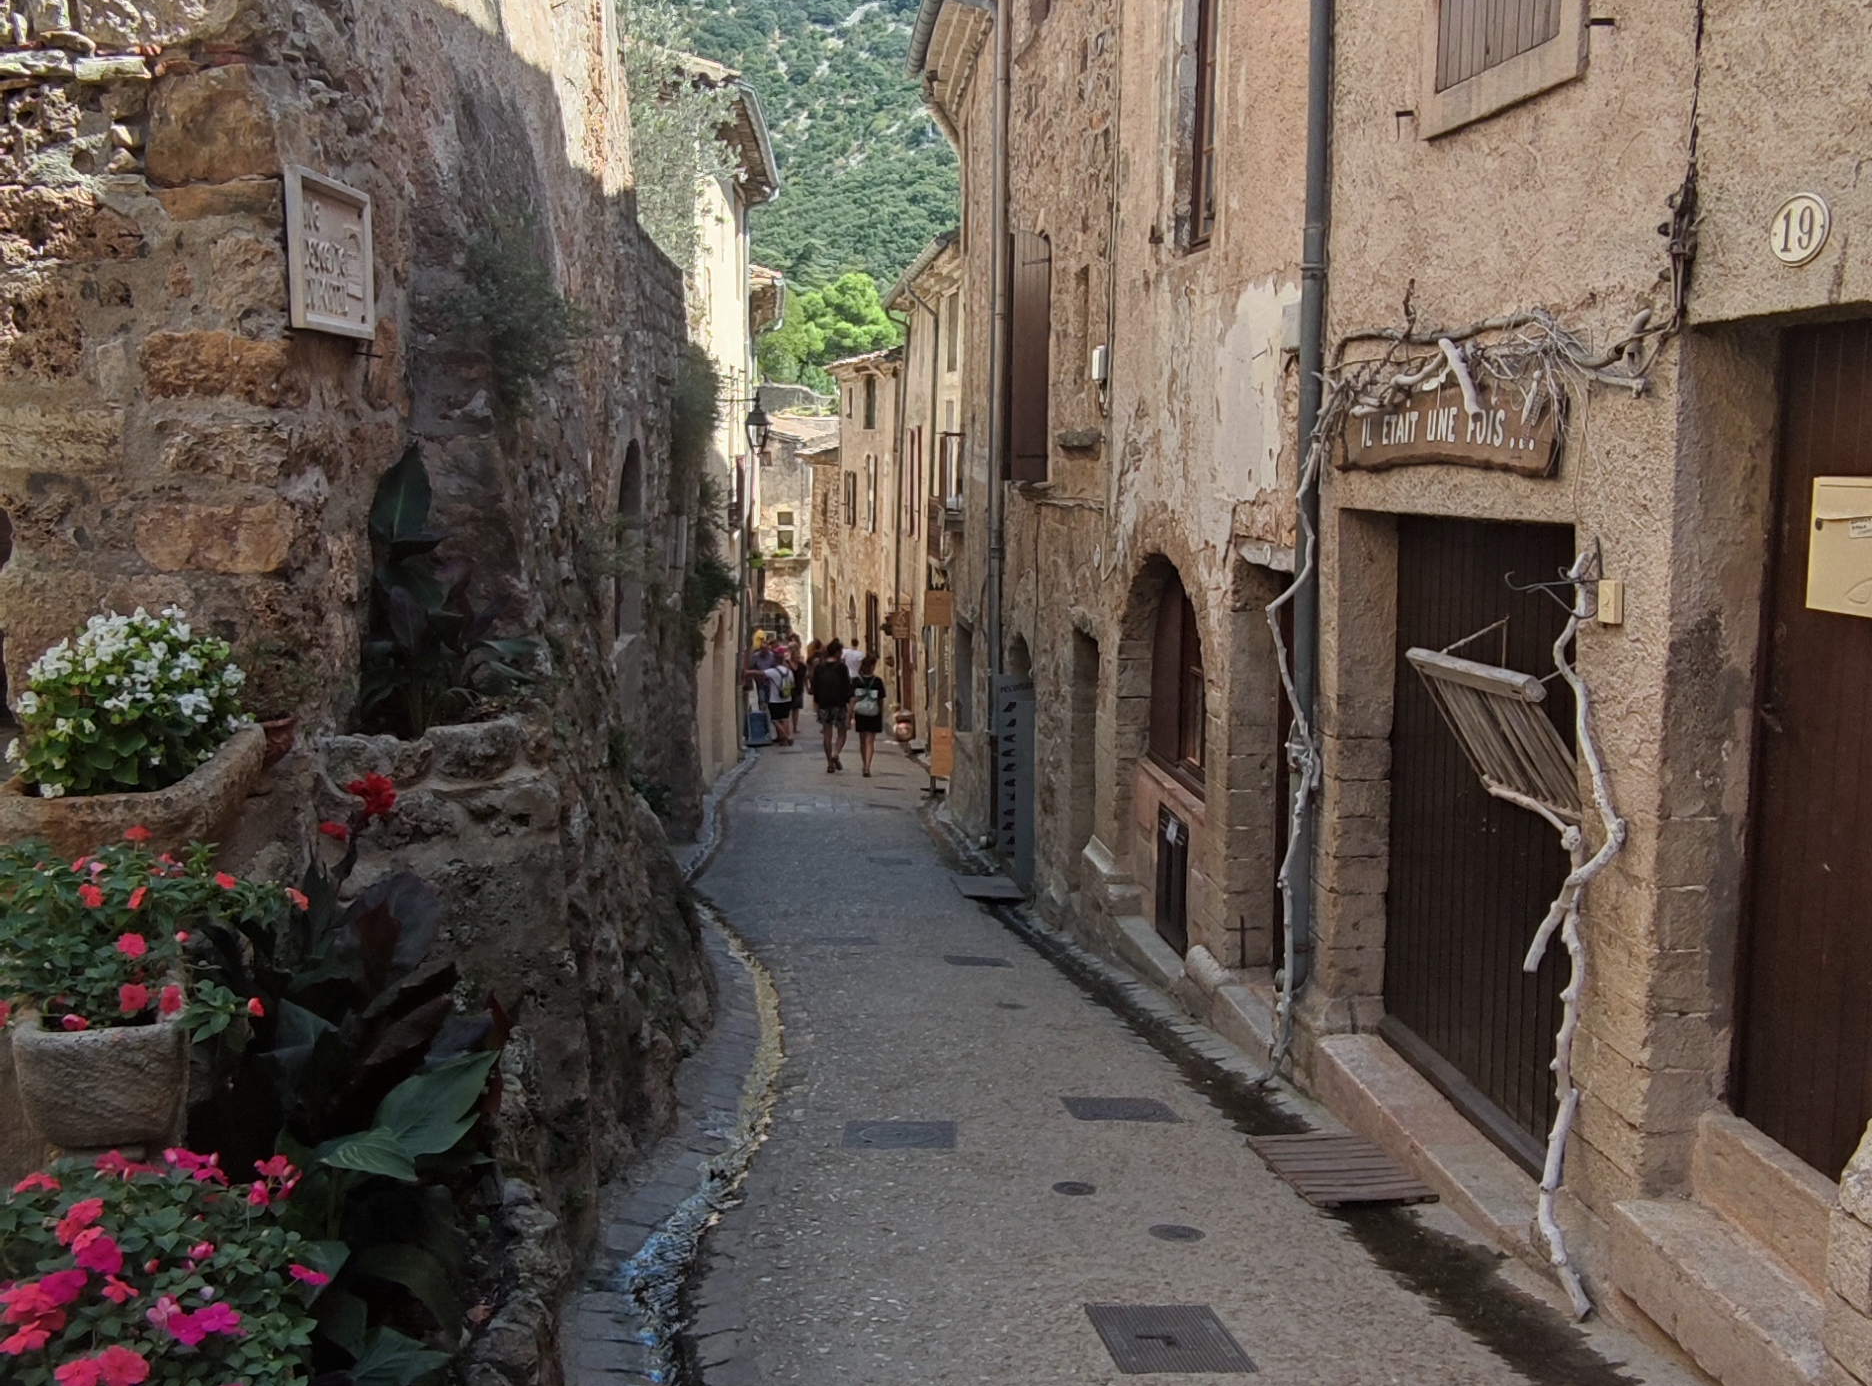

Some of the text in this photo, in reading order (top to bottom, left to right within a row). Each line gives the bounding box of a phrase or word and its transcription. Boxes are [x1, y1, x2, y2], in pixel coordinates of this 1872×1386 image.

[1780, 206, 1814, 253] 19
[1361, 417, 1373, 449] IL
[1426, 406, 1458, 443] UNE
